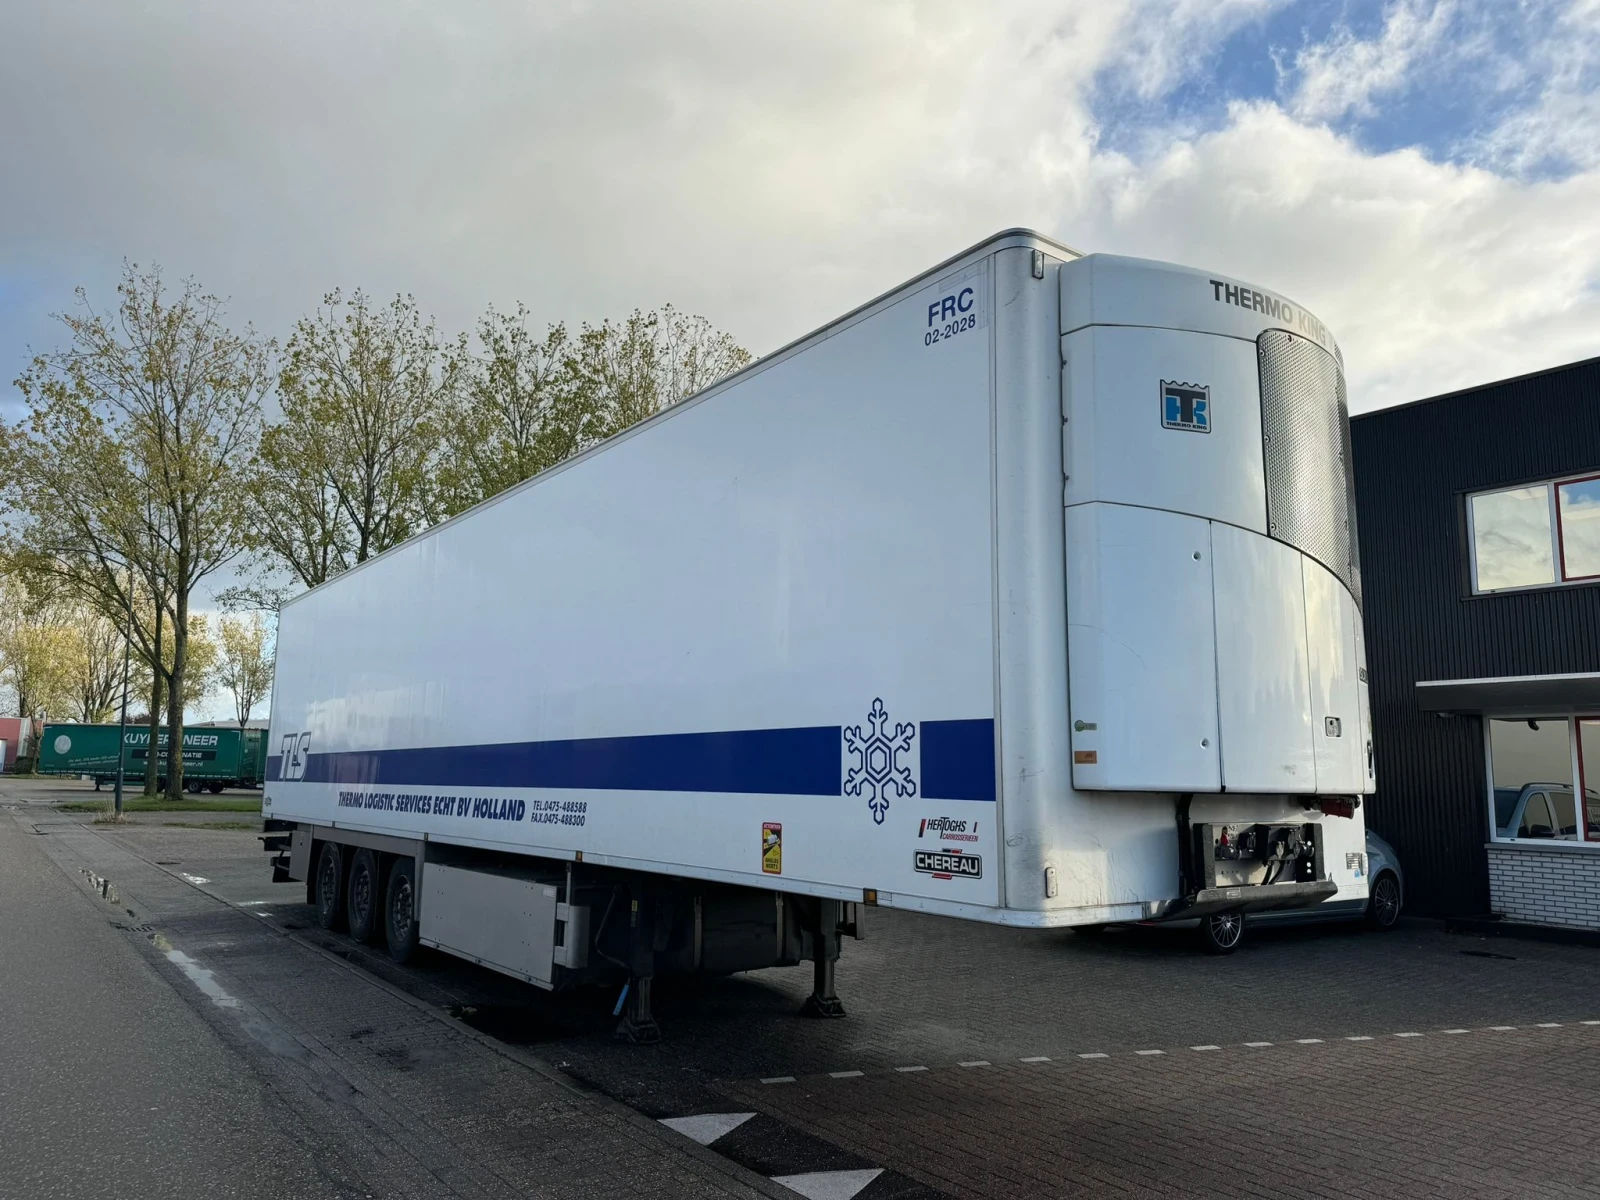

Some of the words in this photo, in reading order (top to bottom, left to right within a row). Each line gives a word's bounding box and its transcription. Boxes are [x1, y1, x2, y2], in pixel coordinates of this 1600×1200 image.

[928, 287, 974, 328] FRC
[1209, 279, 1293, 324] THERMO
[1298, 310, 1326, 346] KING
[924, 313, 976, 347] 02-2028
[277, 731, 312, 782] TLS
[338, 791, 364, 808] THERMO
[364, 793, 395, 811] LOGISTIC
[395, 794, 433, 814] SERVICES
[433, 796, 456, 816] ECHT
[456, 797, 472, 818] BV
[472, 798, 526, 821] HOLLAND
[531, 812, 586, 826] FAX.0475-488300
[533, 800, 588, 813] TEL.0475-488588
[926, 817, 967, 839] HERTOGHS
[916, 854, 979, 873] CHEREAU
